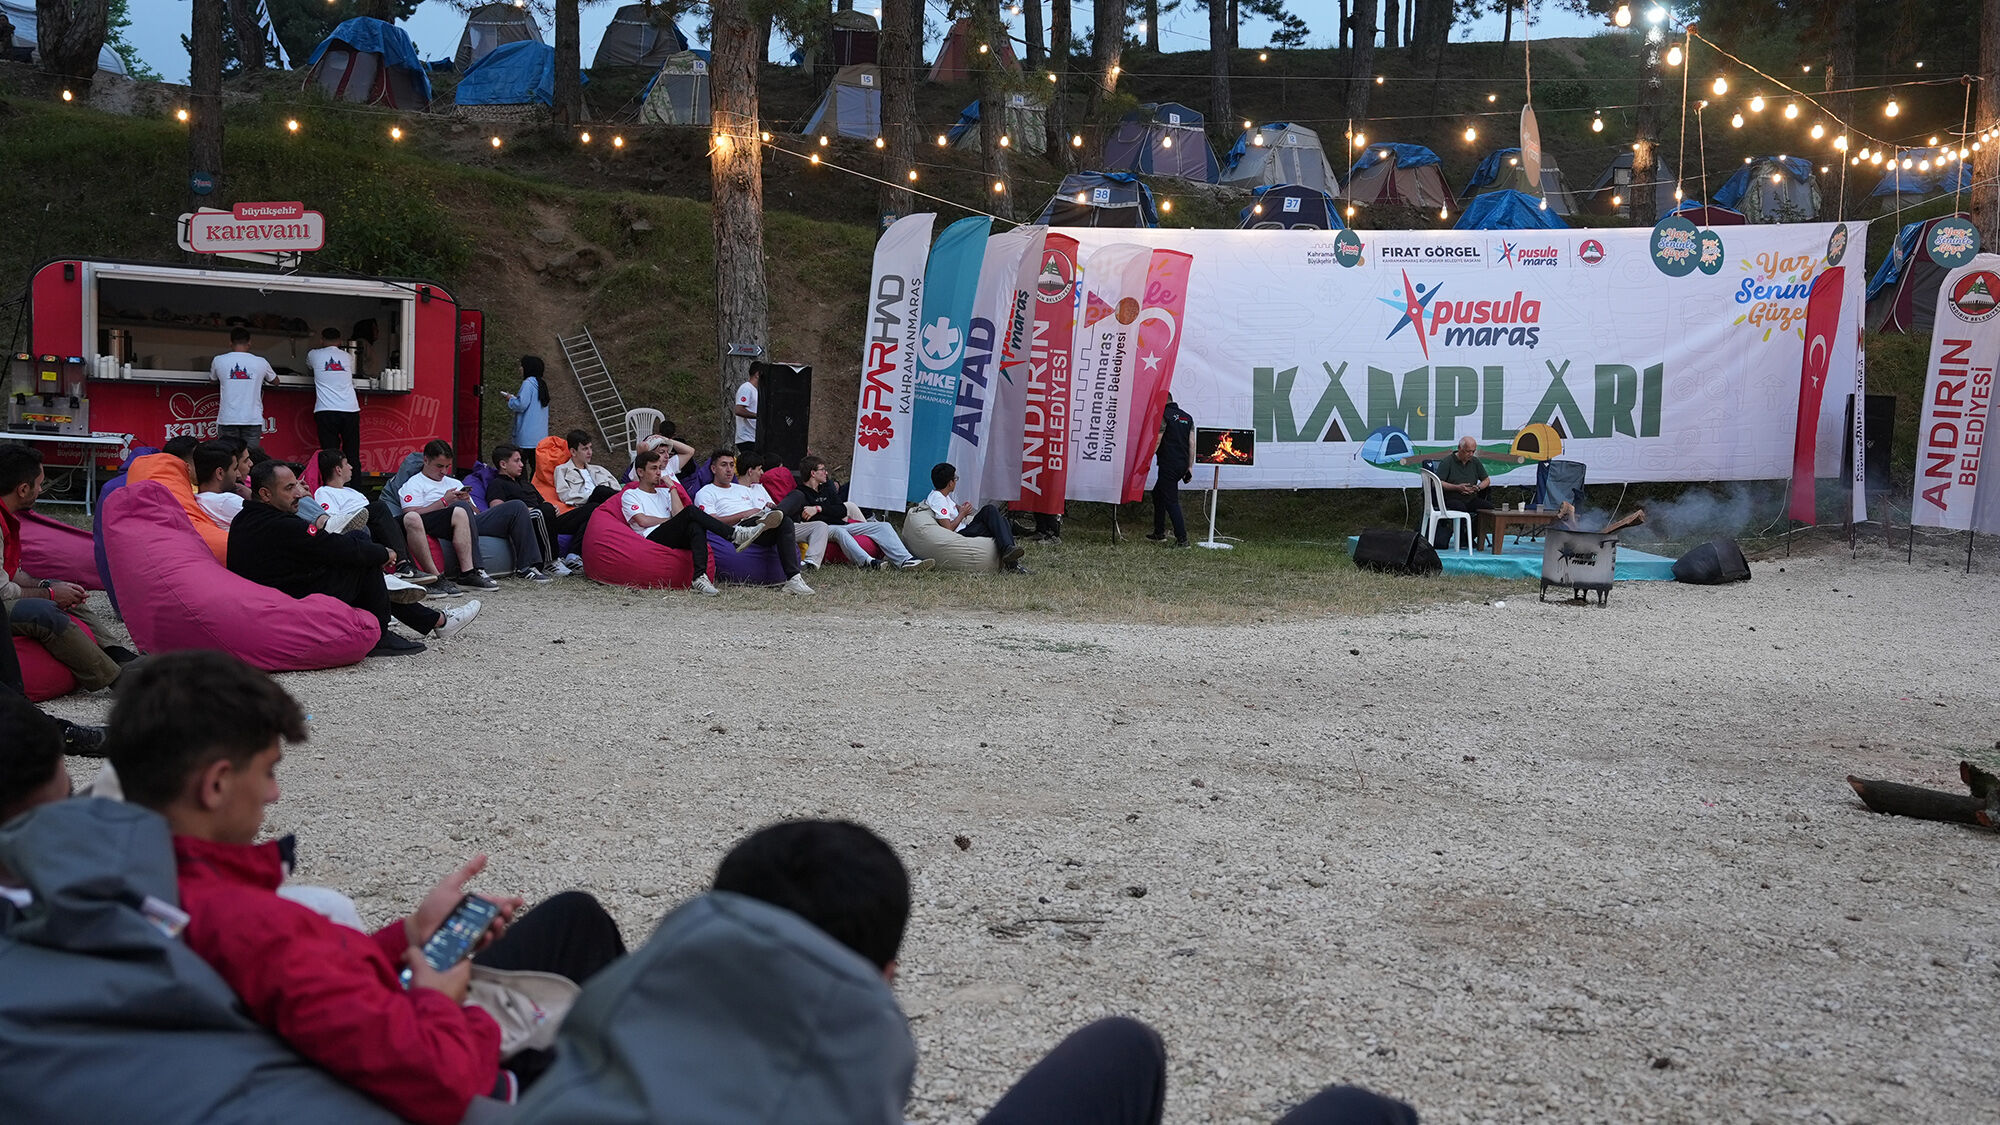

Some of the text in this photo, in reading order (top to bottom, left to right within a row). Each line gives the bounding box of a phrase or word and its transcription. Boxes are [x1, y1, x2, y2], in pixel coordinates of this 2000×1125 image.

[863, 75, 871, 83] 15
[1095, 189, 1108, 199] 38
[1286, 198, 1299, 208] 37
[241, 206, 297, 217] büyükşehir
[1382, 245, 1481, 257] FIRAT GÖRGEL
[1518, 246, 1558, 262] pusula
[1523, 257, 1558, 267] maraş
[1756, 251, 1818, 281] Yaz
[1735, 275, 1820, 304] Seninl
[1012, 289, 1029, 350] maraş
[1430, 291, 1542, 336] pusula
[1748, 302, 1809, 331] Güze
[899, 278, 922, 414] KAHRAMANMARAŞ
[1445, 325, 1540, 350] maraş
[951, 317, 996, 447] AFAD
[1082, 332, 1114, 461] Kahramanmaraş
[1100, 332, 1127, 462] Büyükşehir Belediyesi
[1020, 320, 1050, 496] ANDIRIN
[1048, 349, 1068, 471] BELEDİYESİ
[1921, 339, 1972, 511] ANDIRIN
[1958, 367, 1993, 486] BELEDİYESİ
